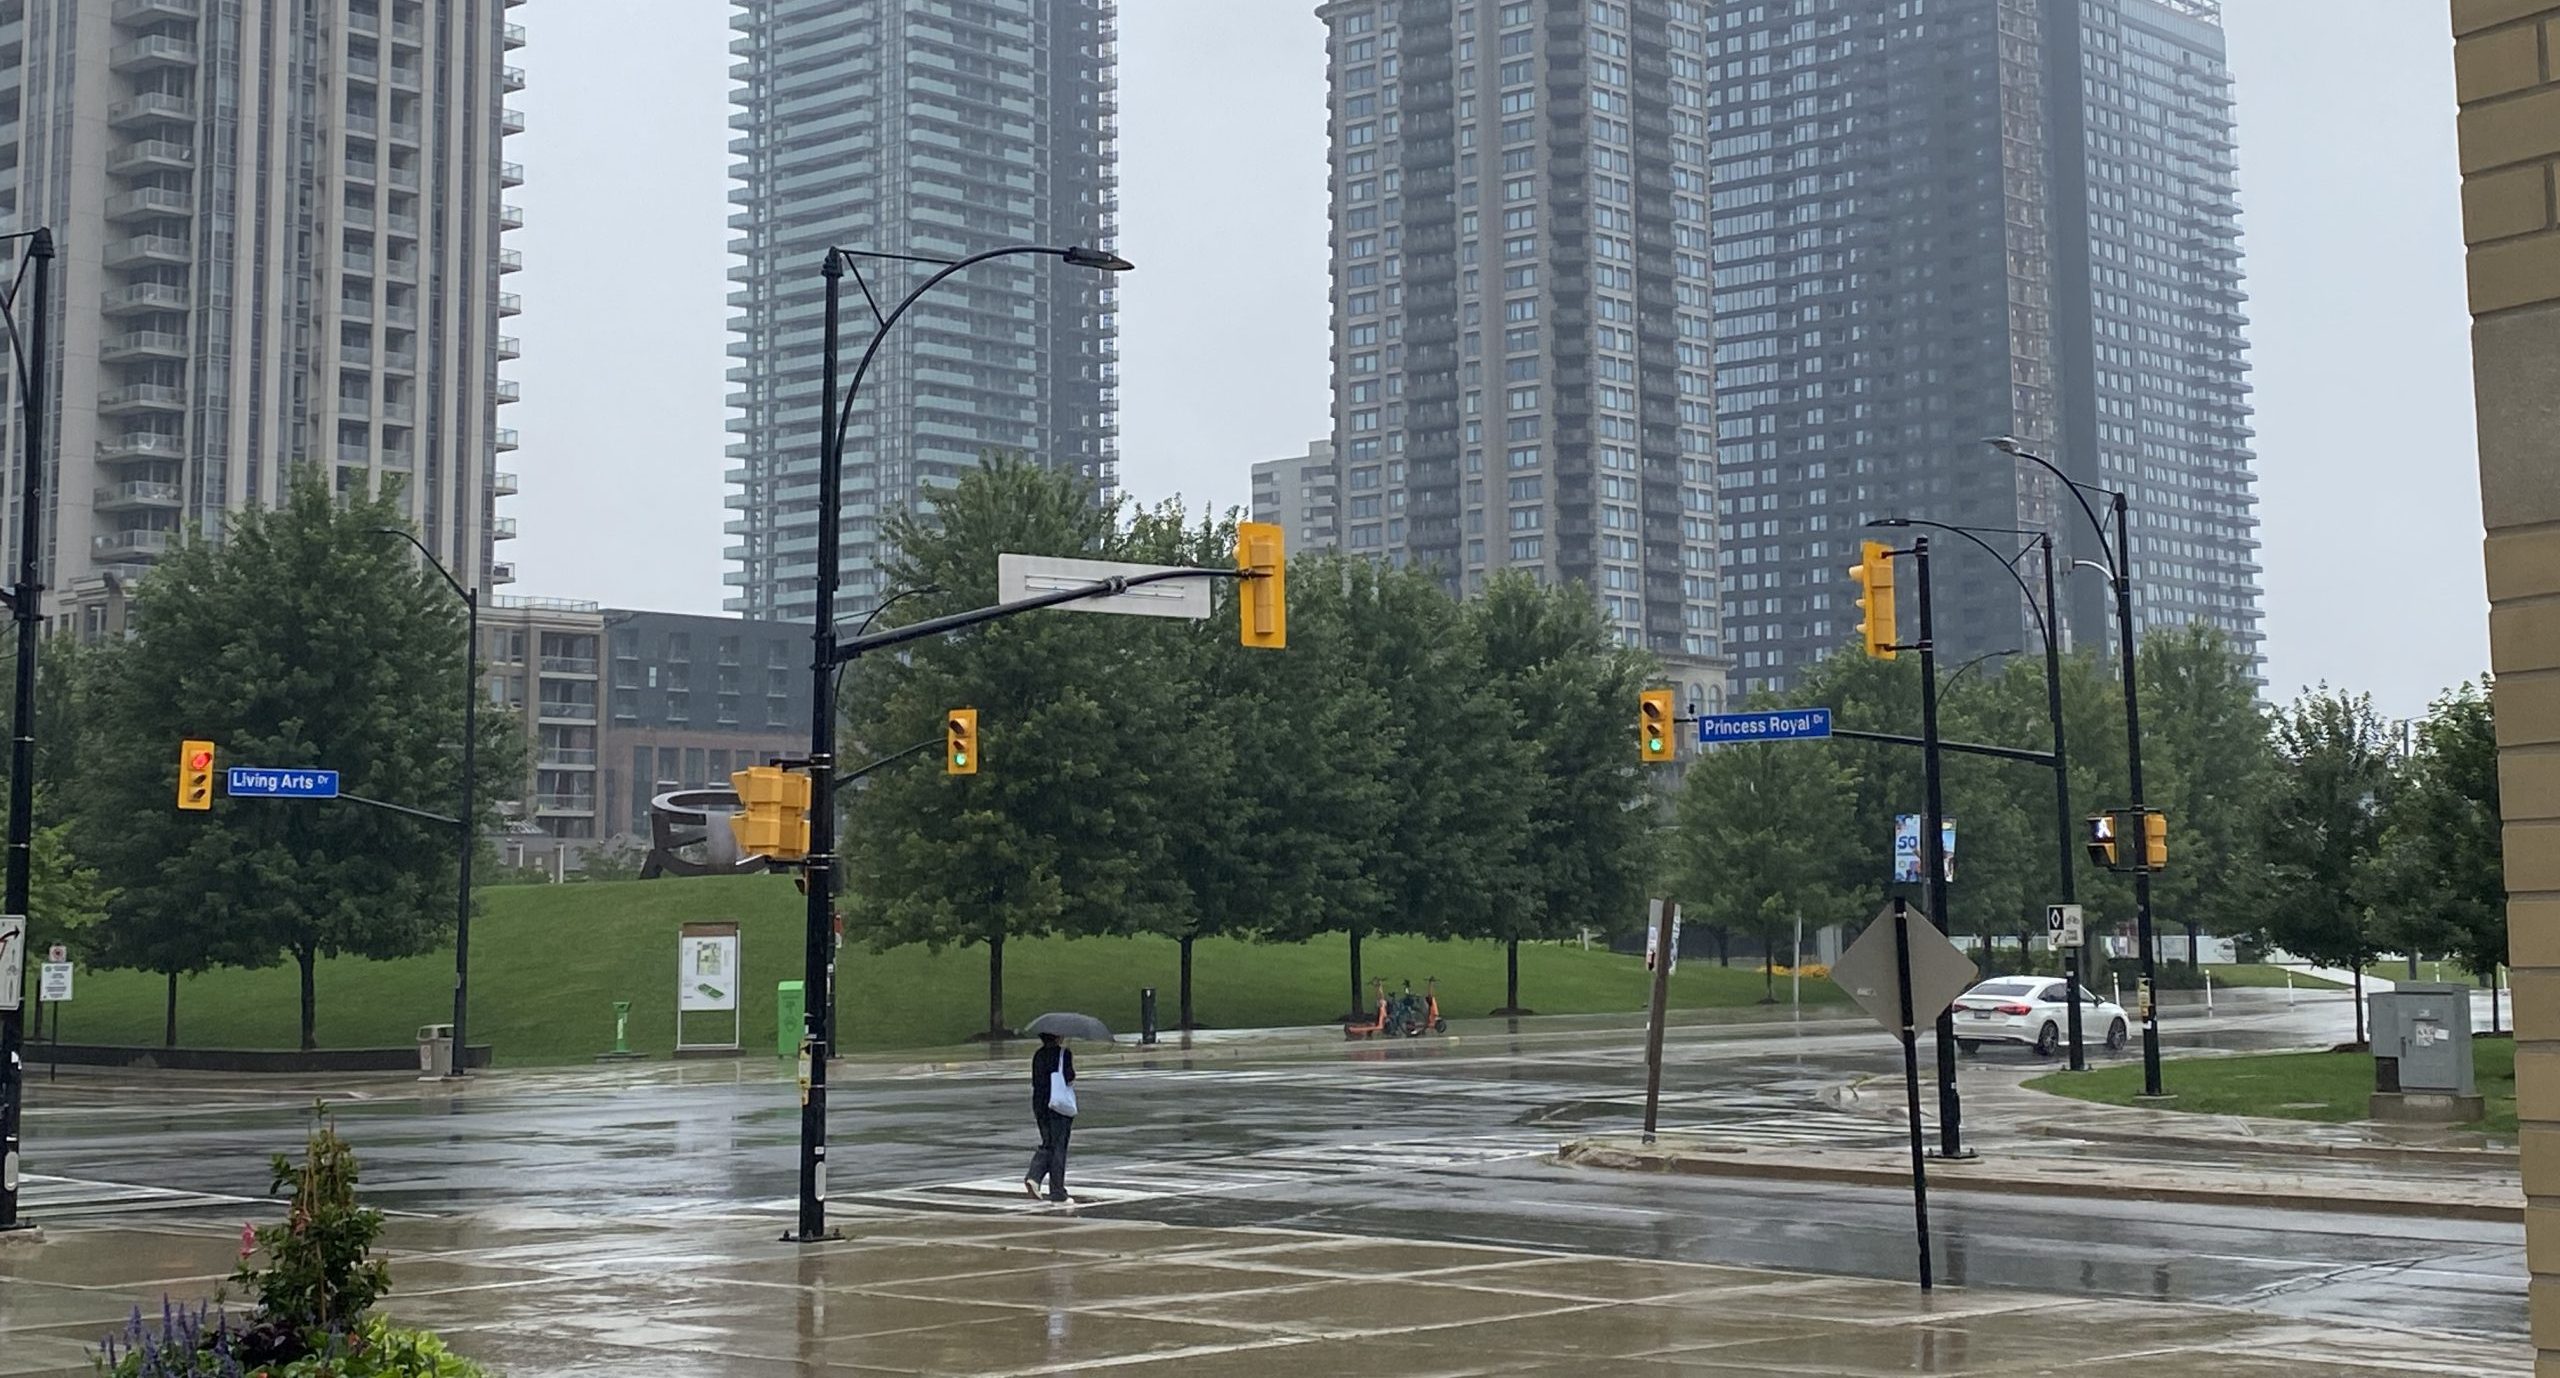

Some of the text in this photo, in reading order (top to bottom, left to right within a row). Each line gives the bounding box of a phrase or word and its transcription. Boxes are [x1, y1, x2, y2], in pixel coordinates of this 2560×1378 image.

[1705, 714, 1824, 735] Princess Royal Dr
[232, 772, 329, 791] Living Arts Dr
